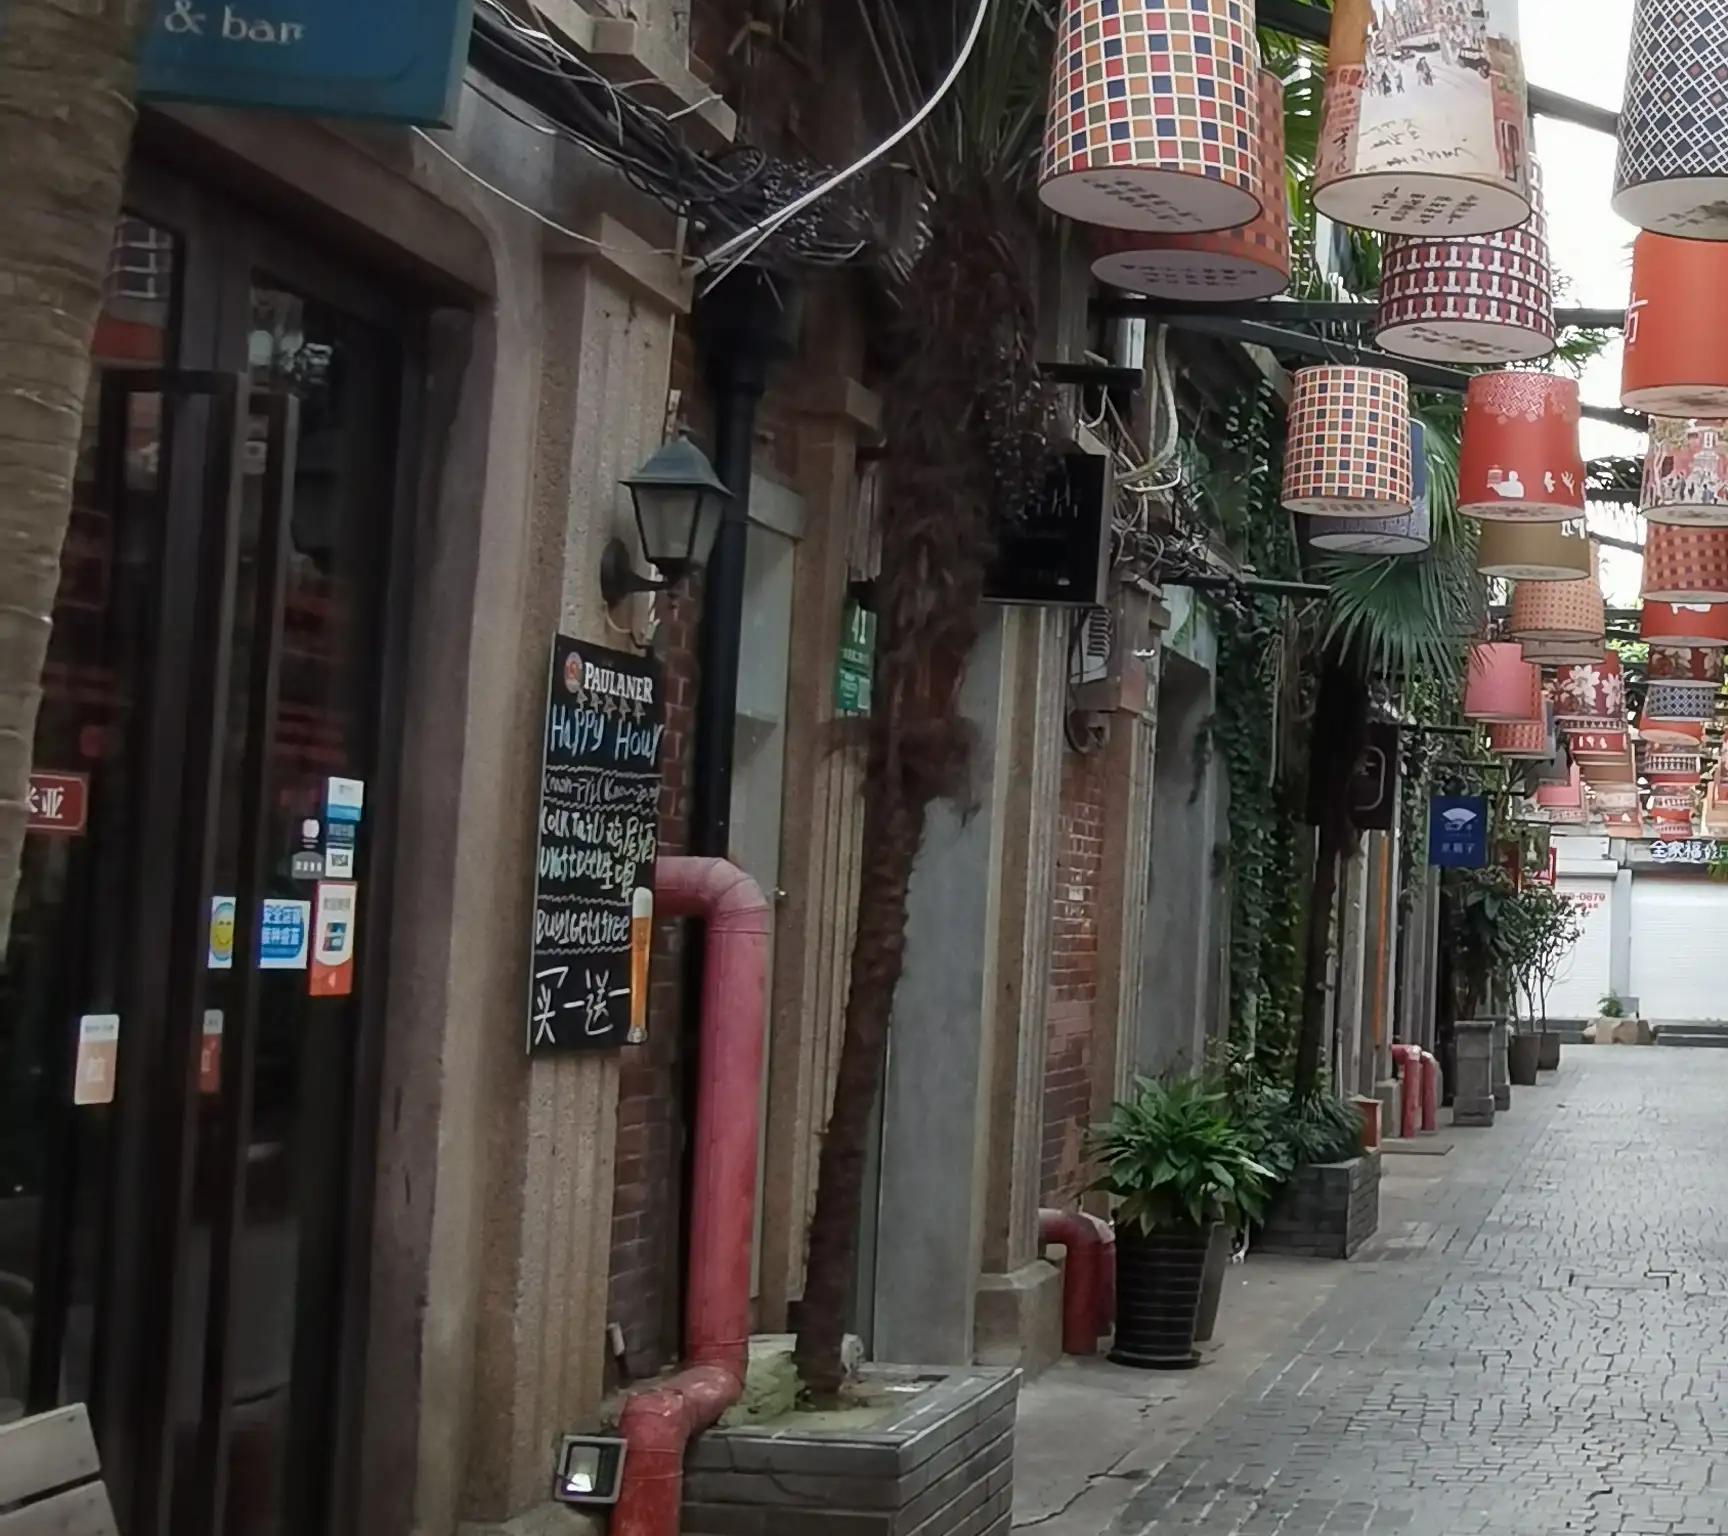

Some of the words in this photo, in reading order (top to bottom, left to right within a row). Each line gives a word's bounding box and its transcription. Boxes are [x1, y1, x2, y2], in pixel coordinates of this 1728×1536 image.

[164, 2, 205, 38] &
[221, 6, 306, 44] bar
[584, 662, 653, 704] PAULANER
[533, 966, 630, 1045] 买一送一
